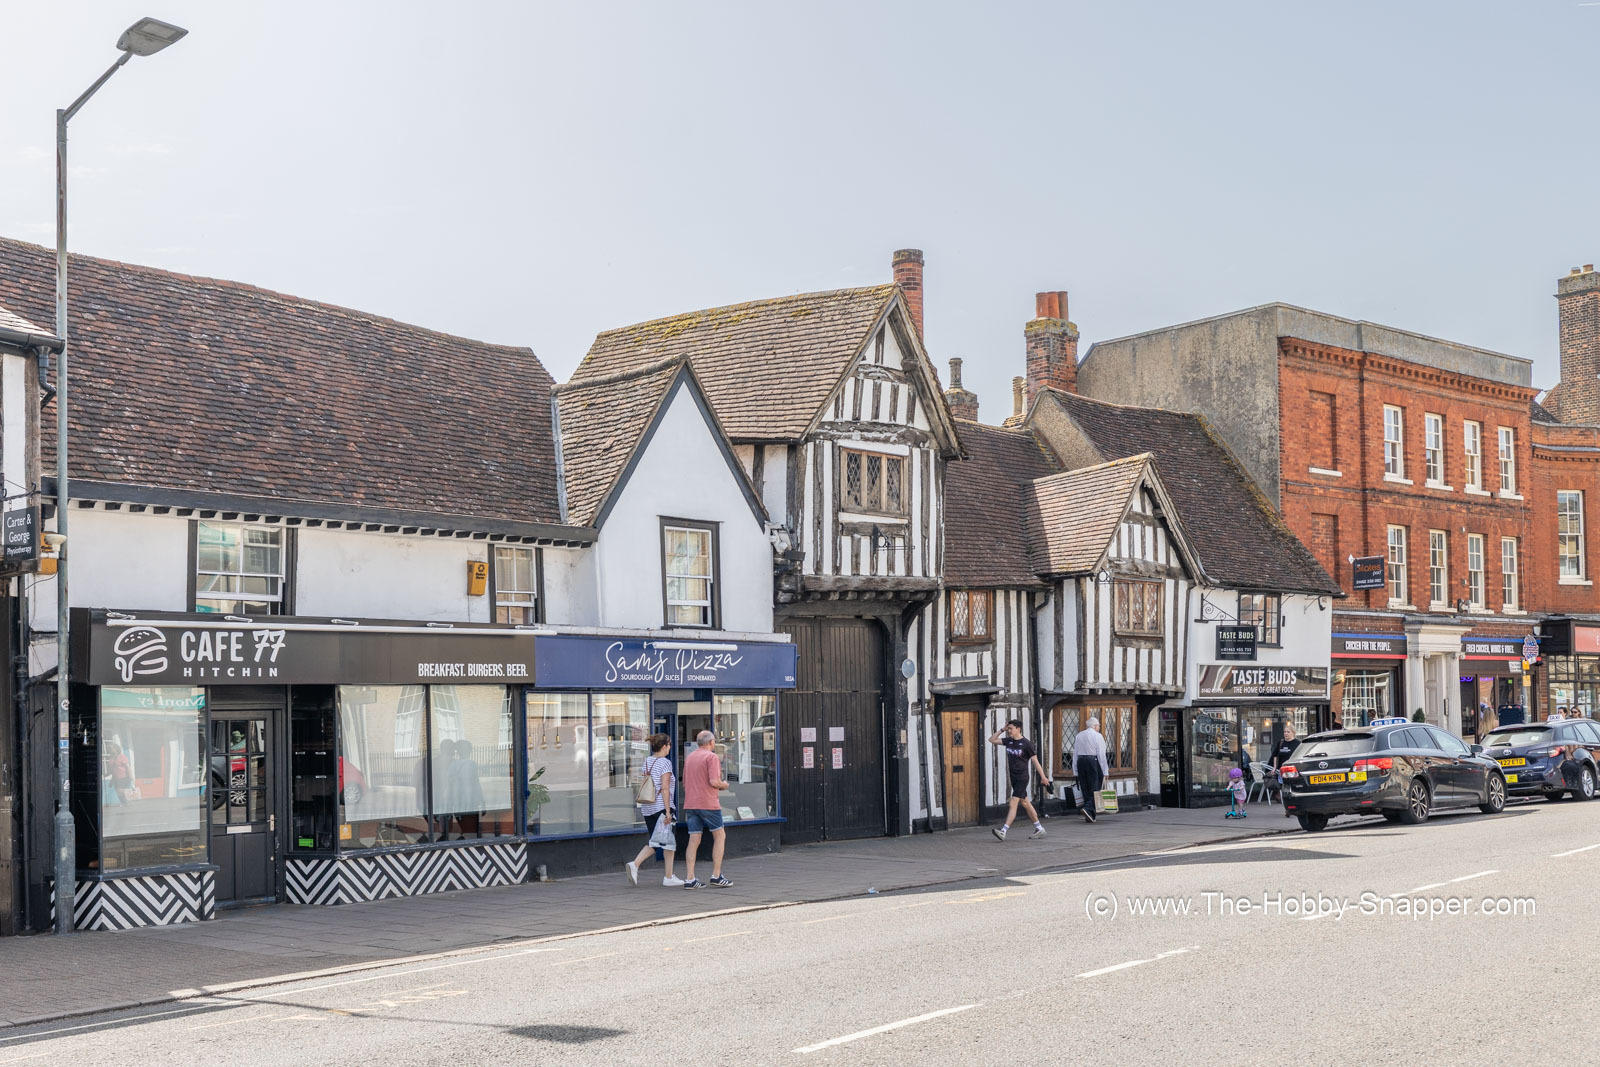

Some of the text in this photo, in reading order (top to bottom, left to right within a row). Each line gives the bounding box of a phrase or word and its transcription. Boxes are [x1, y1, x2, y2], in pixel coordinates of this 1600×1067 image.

[7, 513, 32, 528] Carter &
[9, 531, 30, 544] George
[6, 546, 32, 556] Physiotherapy
[1218, 631, 1254, 640] TASTE BUDS
[180, 629, 286, 663] CAFE 77
[605, 641, 744, 685] Sam's Pizza
[183, 667, 278, 677] HITCHIN
[418, 663, 529, 677] BREAKFAST. BURGERS. BEER.
[620, 673, 653, 681] SOURDOUGH
[687, 674, 717, 682] STONEBAKED
[1231, 669, 1297, 685] TASTE BUDS
[1233, 686, 1243, 694] THE
[1243, 686, 1258, 694] HOME
[1258, 686, 1265, 694] OF
[1266, 686, 1281, 694] GREAT
[1281, 686, 1295, 694] FOOD
[1199, 723, 1229, 733] COFFEE
[1328, 773, 1342, 781] KRN
